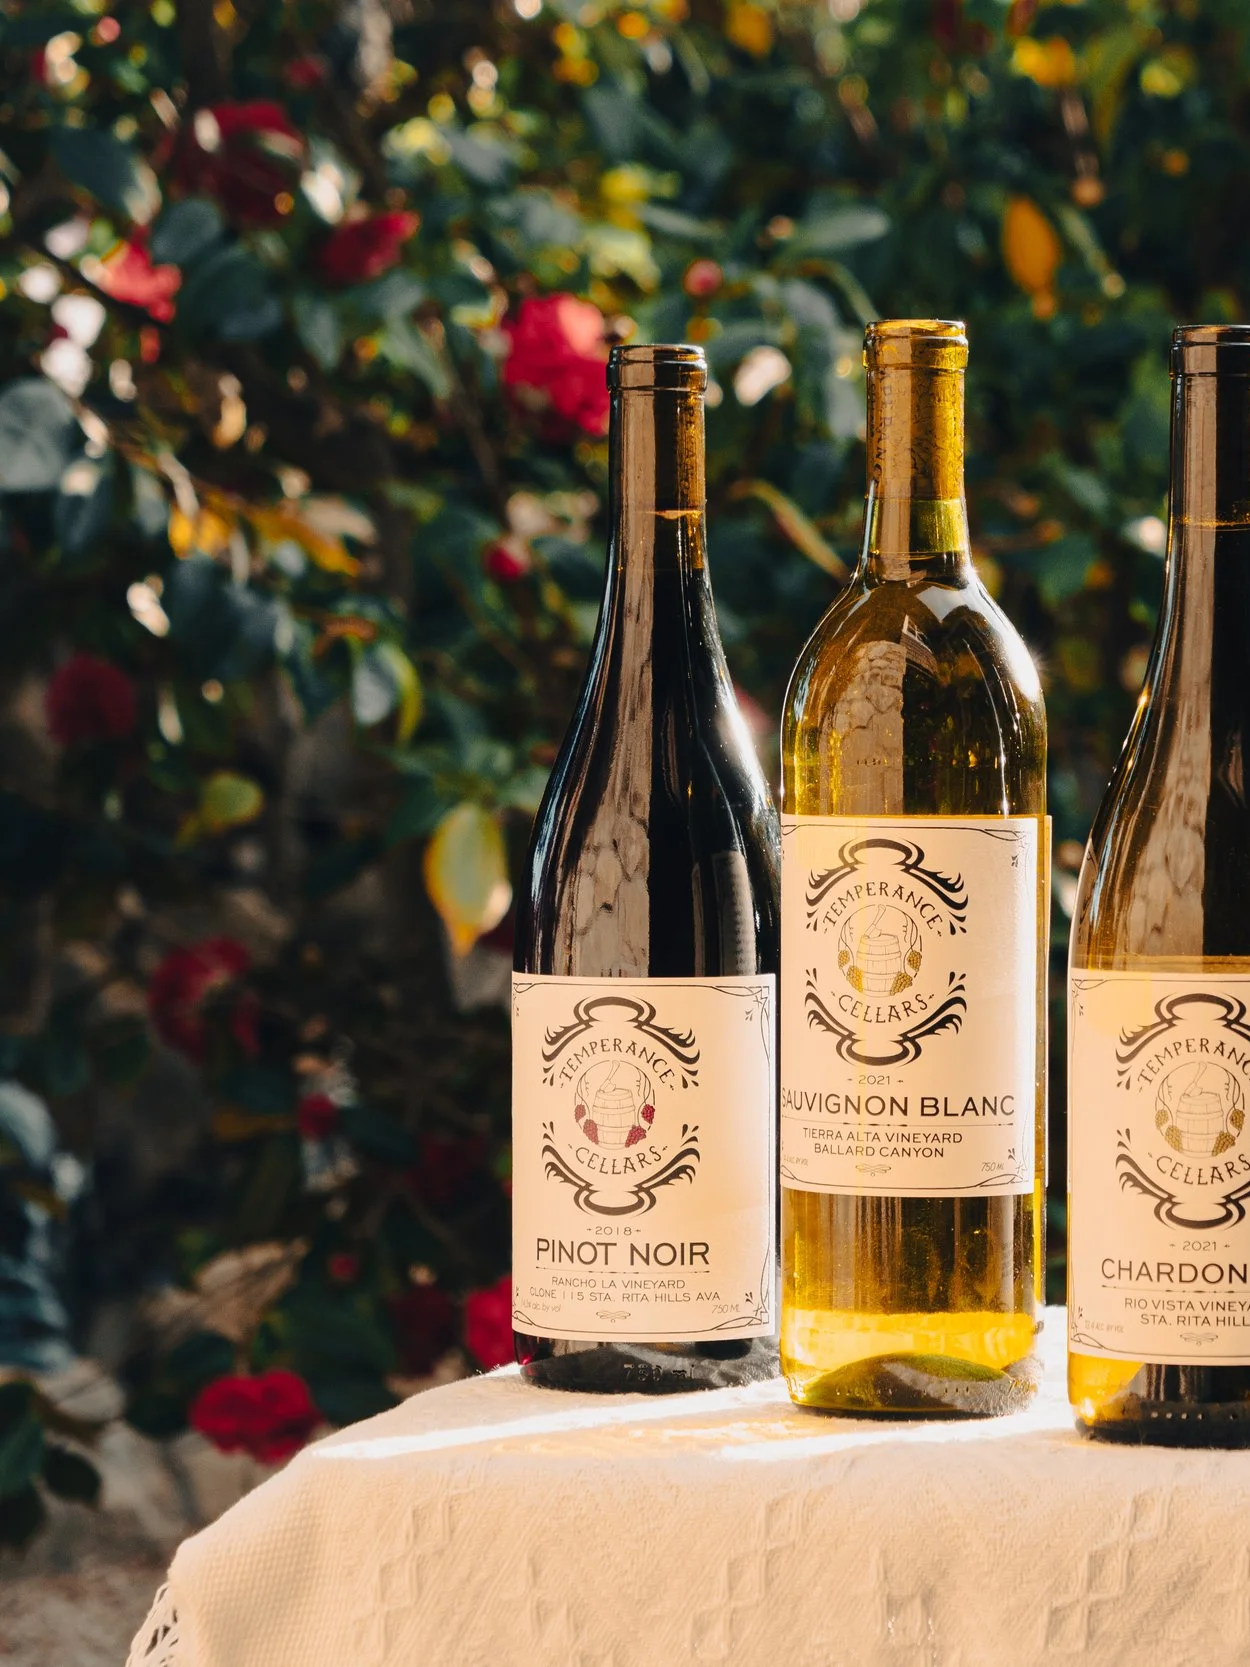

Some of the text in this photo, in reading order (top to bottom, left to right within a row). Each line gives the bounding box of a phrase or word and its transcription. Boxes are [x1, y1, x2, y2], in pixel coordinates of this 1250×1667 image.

[822, 881, 943, 930] TEMPERANCE
[838, 993, 928, 1024] CELLARS
[559, 1038, 675, 1084] TEMPERANCE
[858, 1075, 890, 1085] 2021
[782, 1087, 1015, 1117] SAUVIGNON BLANC
[803, 1127, 963, 1143] TIERRA ALTA VINEYARD
[814, 1143, 944, 1158] BALLARD CANYON
[575, 1145, 662, 1175] CELLARS
[981, 1162, 996, 1172] 750
[595, 1226, 632, 1236] 2018
[536, 1237, 710, 1266] PINOT NOIR
[1182, 1241, 1217, 1251] 2021
[551, 1276, 686, 1289] RANCHO LA VINEYARD
[529, 1286, 557, 1299] CLONE
[589, 1292, 616, 1302] STA.
[622, 1293, 650, 1302] RITA
[655, 1292, 691, 1303] HILLS
[696, 1291, 721, 1301] AVA
[711, 1304, 728, 1314] 750
[1124, 1298, 1148, 1310] RIO
[1151, 1299, 1195, 1311] VISTA
[1140, 1313, 1172, 1326] STA.
[1177, 1315, 1211, 1326] RITA
